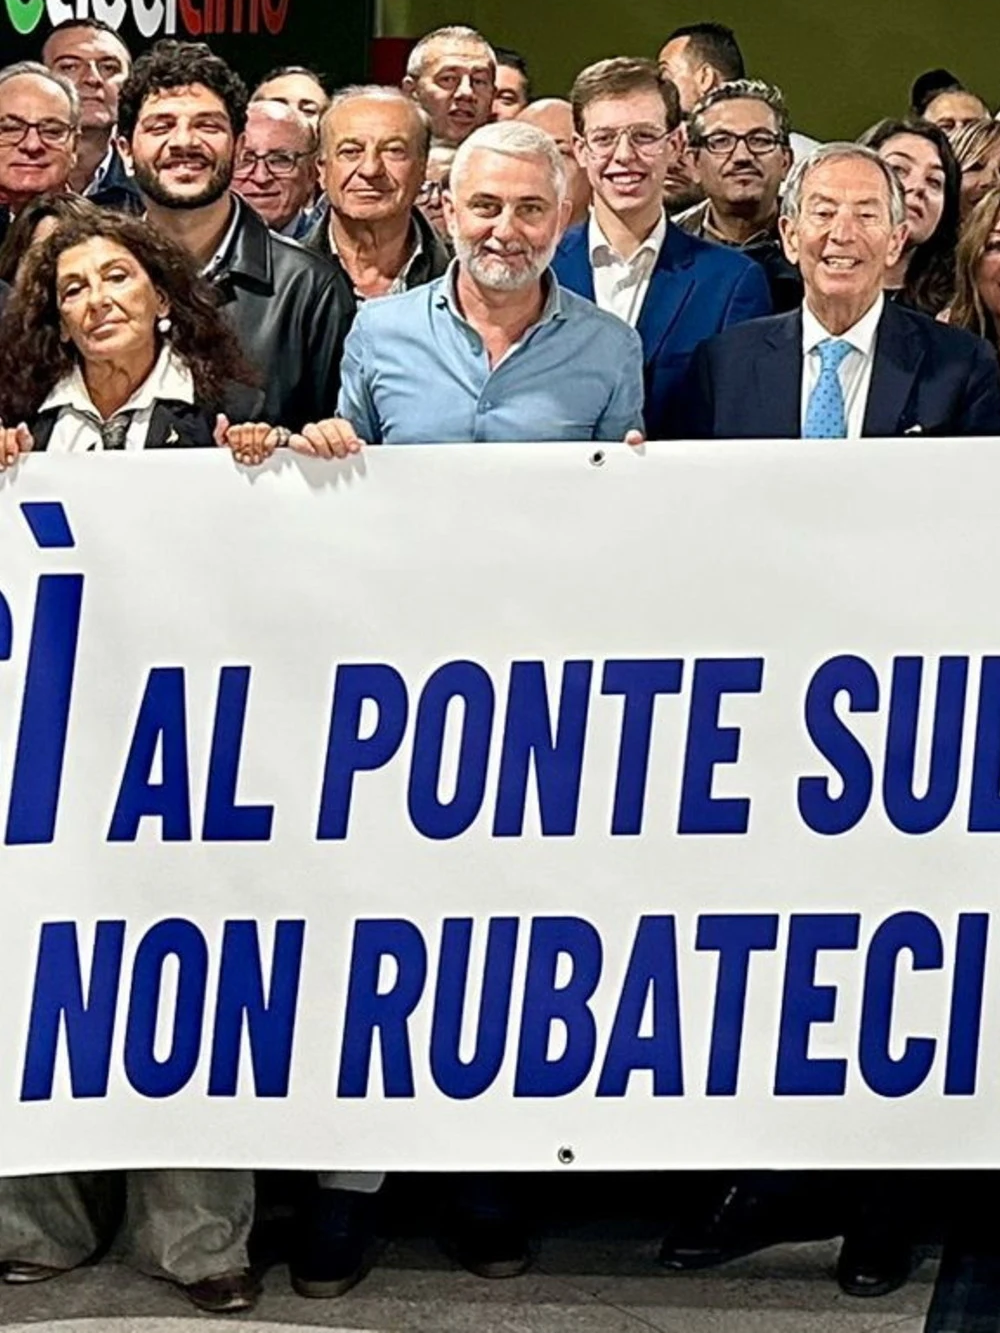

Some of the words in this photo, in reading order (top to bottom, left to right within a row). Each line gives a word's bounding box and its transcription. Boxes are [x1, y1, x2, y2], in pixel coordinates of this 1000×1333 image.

[0, 501, 84, 845] Ì
[106, 665, 274, 841] AL
[316, 657, 764, 840] PONTE
[20, 917, 306, 1100] NON
[337, 910, 989, 1099] RUBATECI
